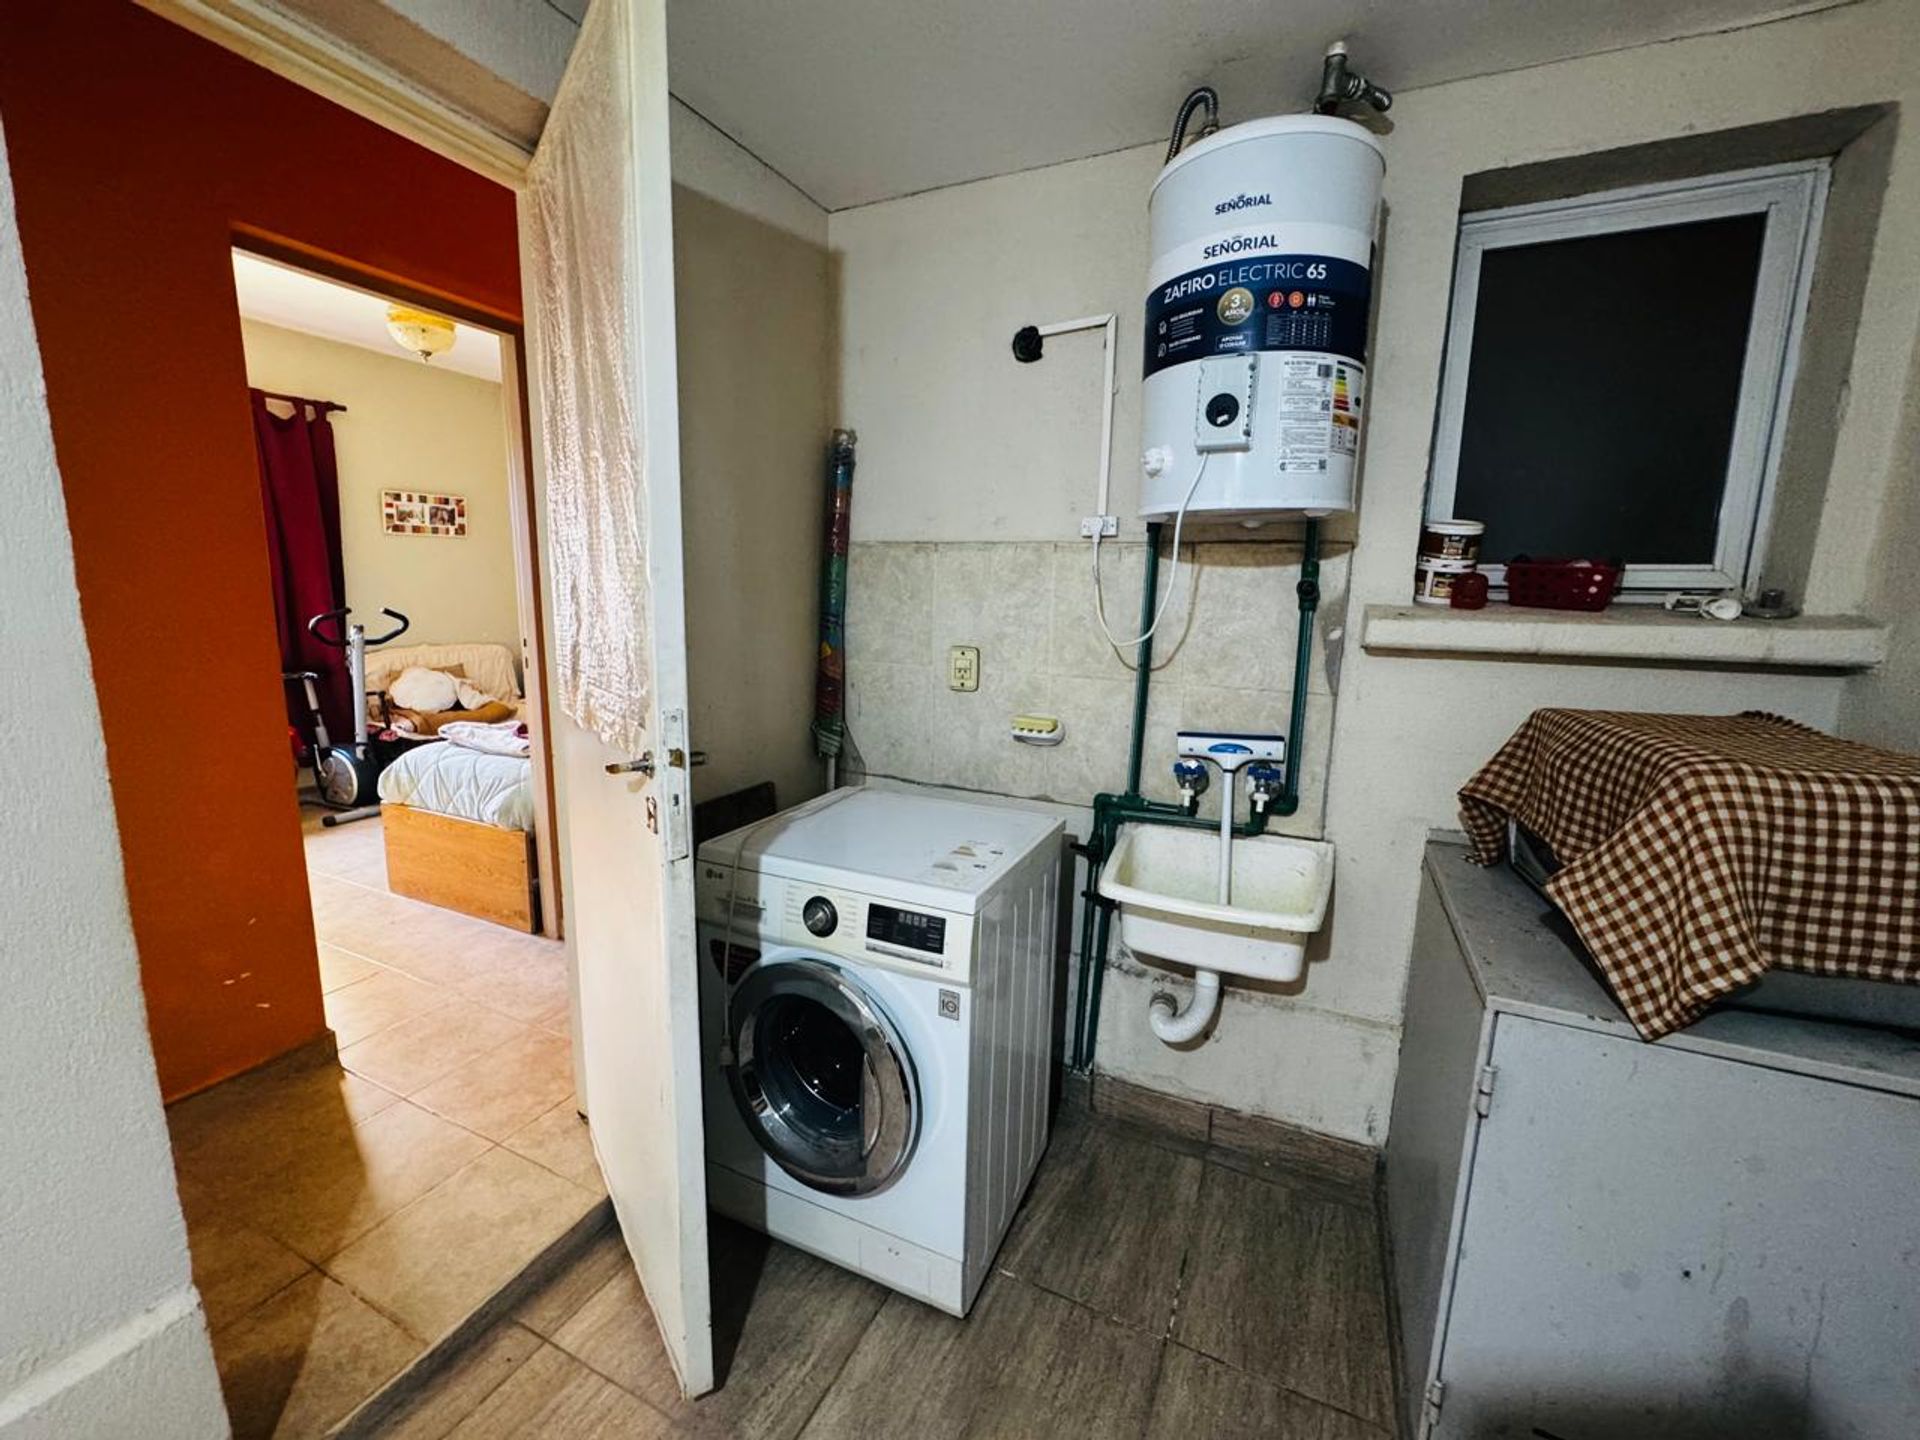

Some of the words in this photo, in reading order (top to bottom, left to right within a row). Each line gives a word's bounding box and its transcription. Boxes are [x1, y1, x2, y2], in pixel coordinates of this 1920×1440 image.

[1214, 193, 1272, 215] SEÑORIAL
[1202, 234, 1278, 260] SEÑORIAL
[1164, 273, 1215, 304] ZAFIRO
[1218, 263, 1304, 287] ELECTRIC
[1306, 263, 1328, 280] 65
[1230, 294, 1241, 308] 3
